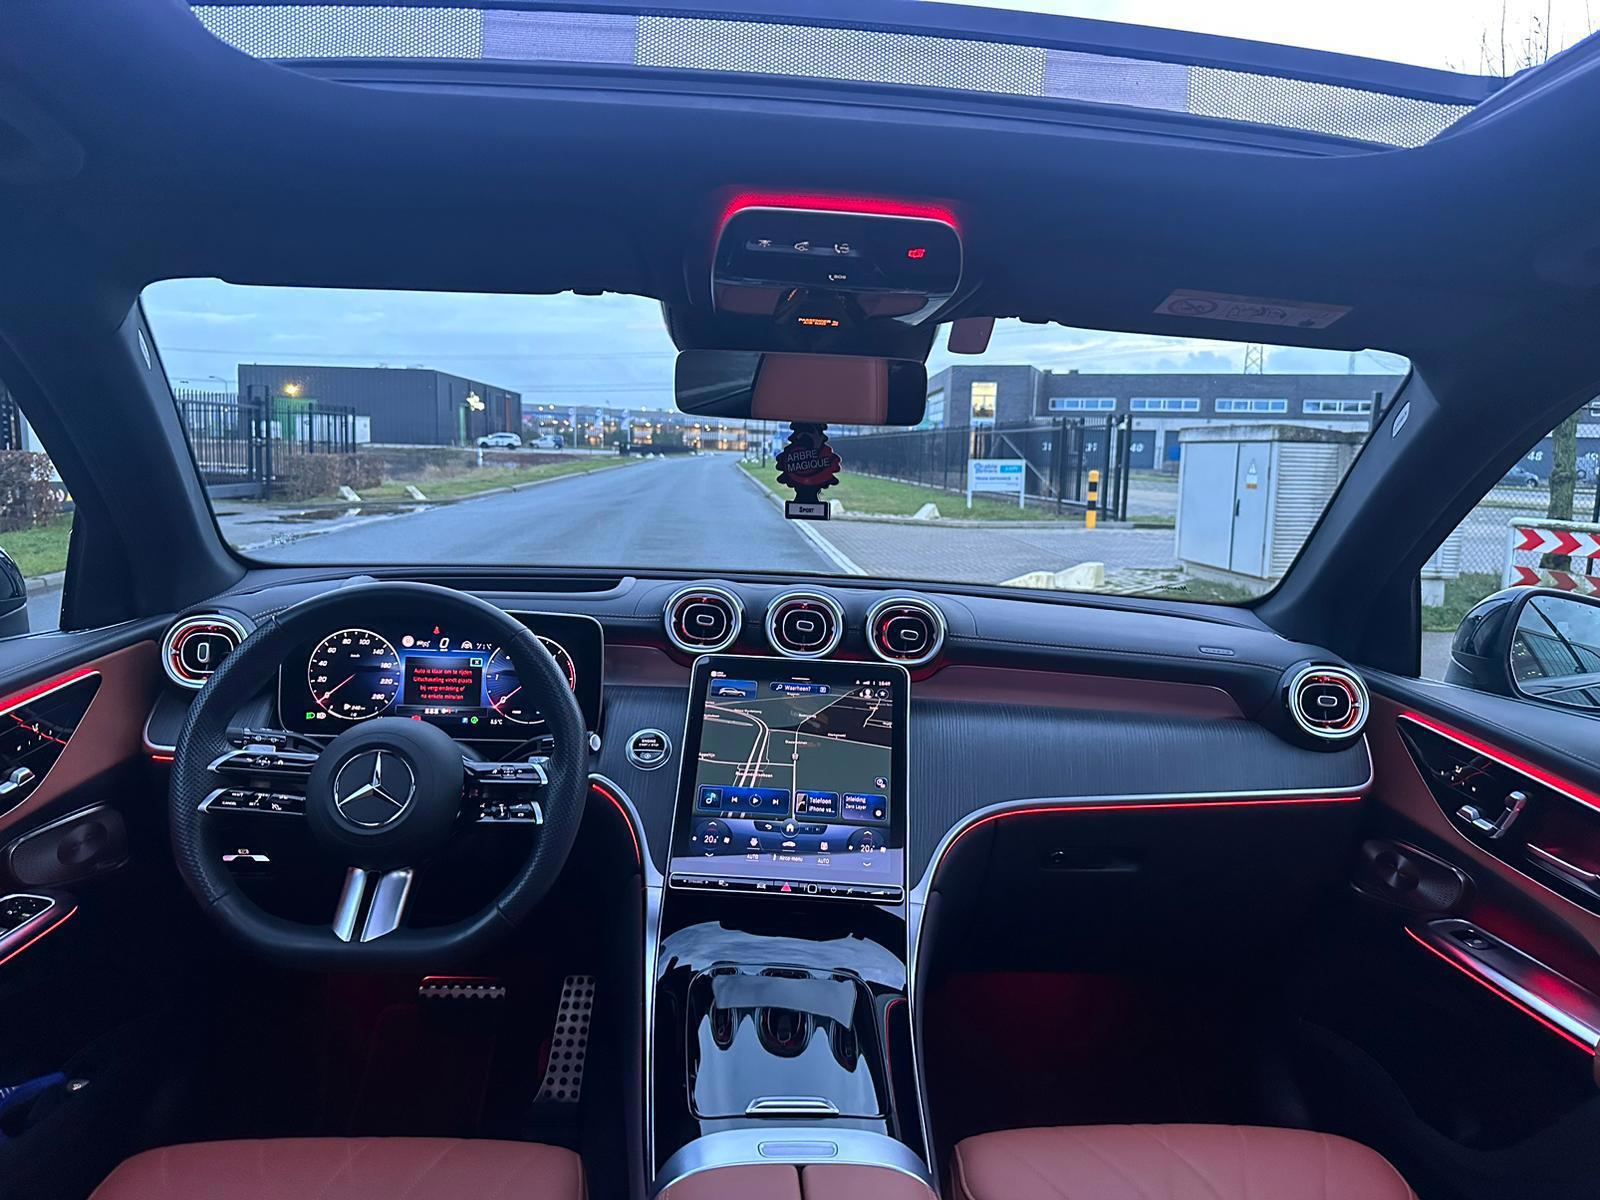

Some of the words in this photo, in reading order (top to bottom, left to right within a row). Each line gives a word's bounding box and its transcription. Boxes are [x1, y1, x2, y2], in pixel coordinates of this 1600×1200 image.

[787, 449, 818, 462] ARBRE
[787, 458, 829, 472] MAGIQUE
[439, 637, 450, 649] 0
[317, 675, 327, 683] 20
[809, 797, 832, 805] Telefoon
[808, 805, 825, 813] iPhone
